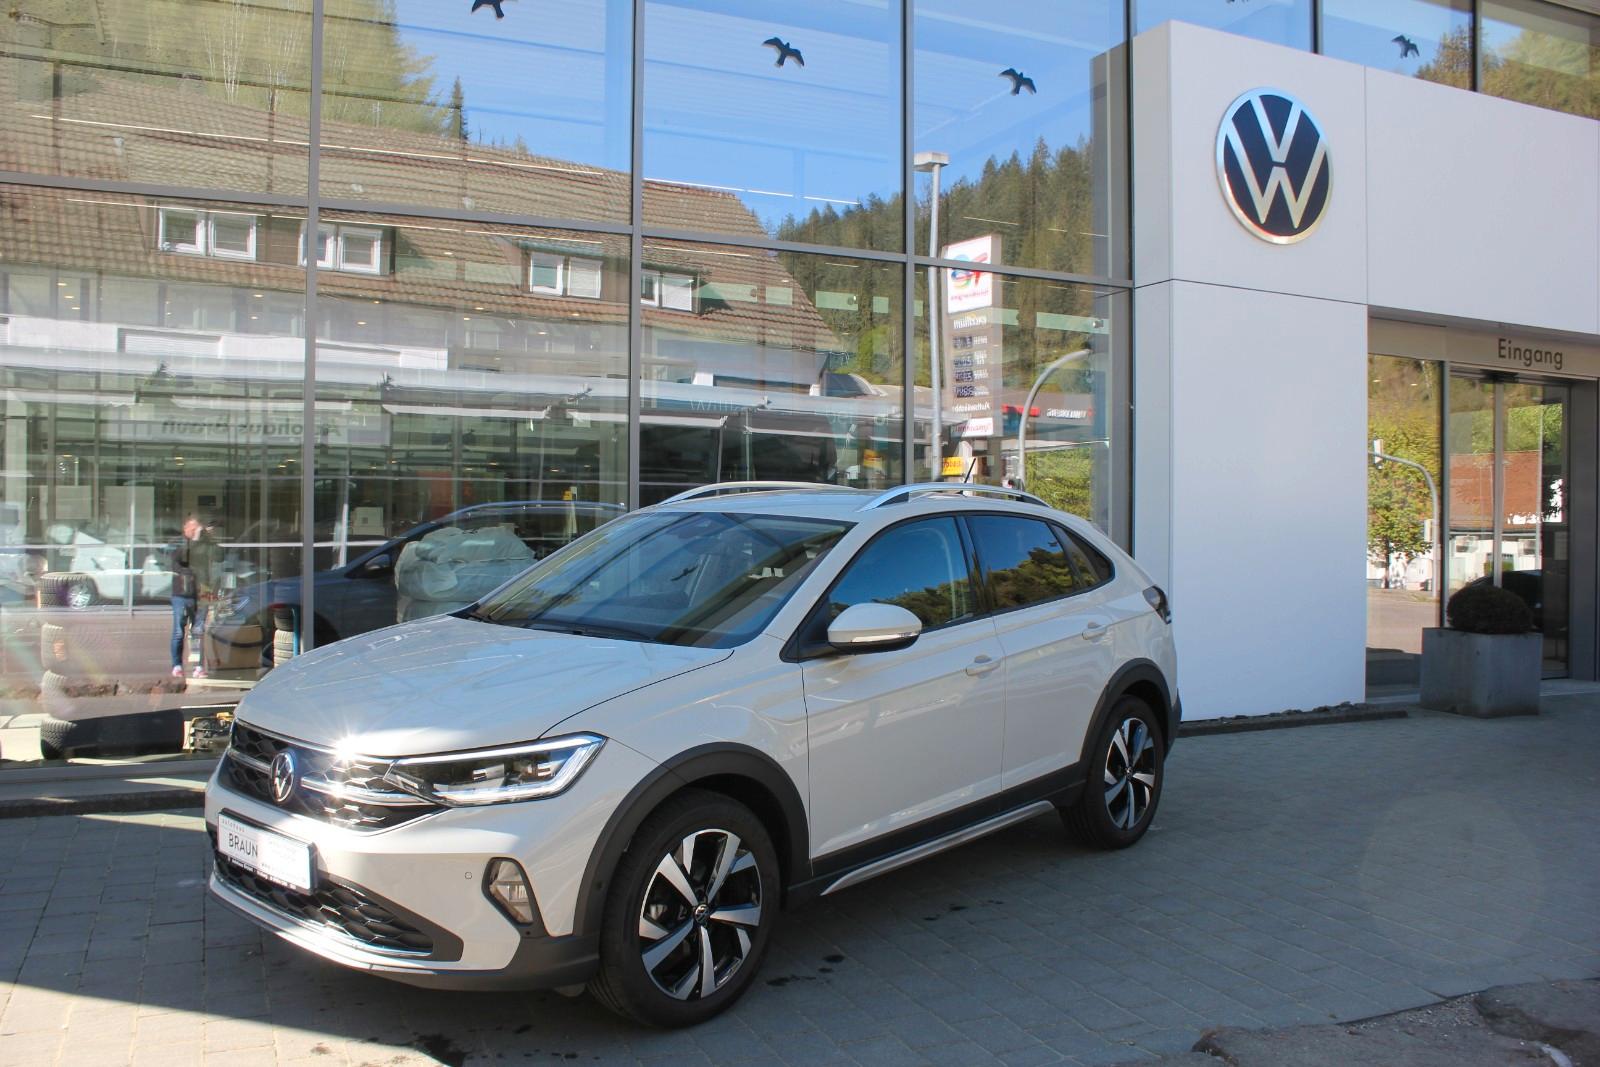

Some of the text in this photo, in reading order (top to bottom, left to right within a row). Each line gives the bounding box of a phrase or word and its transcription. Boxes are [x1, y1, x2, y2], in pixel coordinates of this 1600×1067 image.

[1217, 90, 1331, 240] VW
[1498, 338, 1563, 370] Eingang
[228, 832, 258, 858] BRAUN
